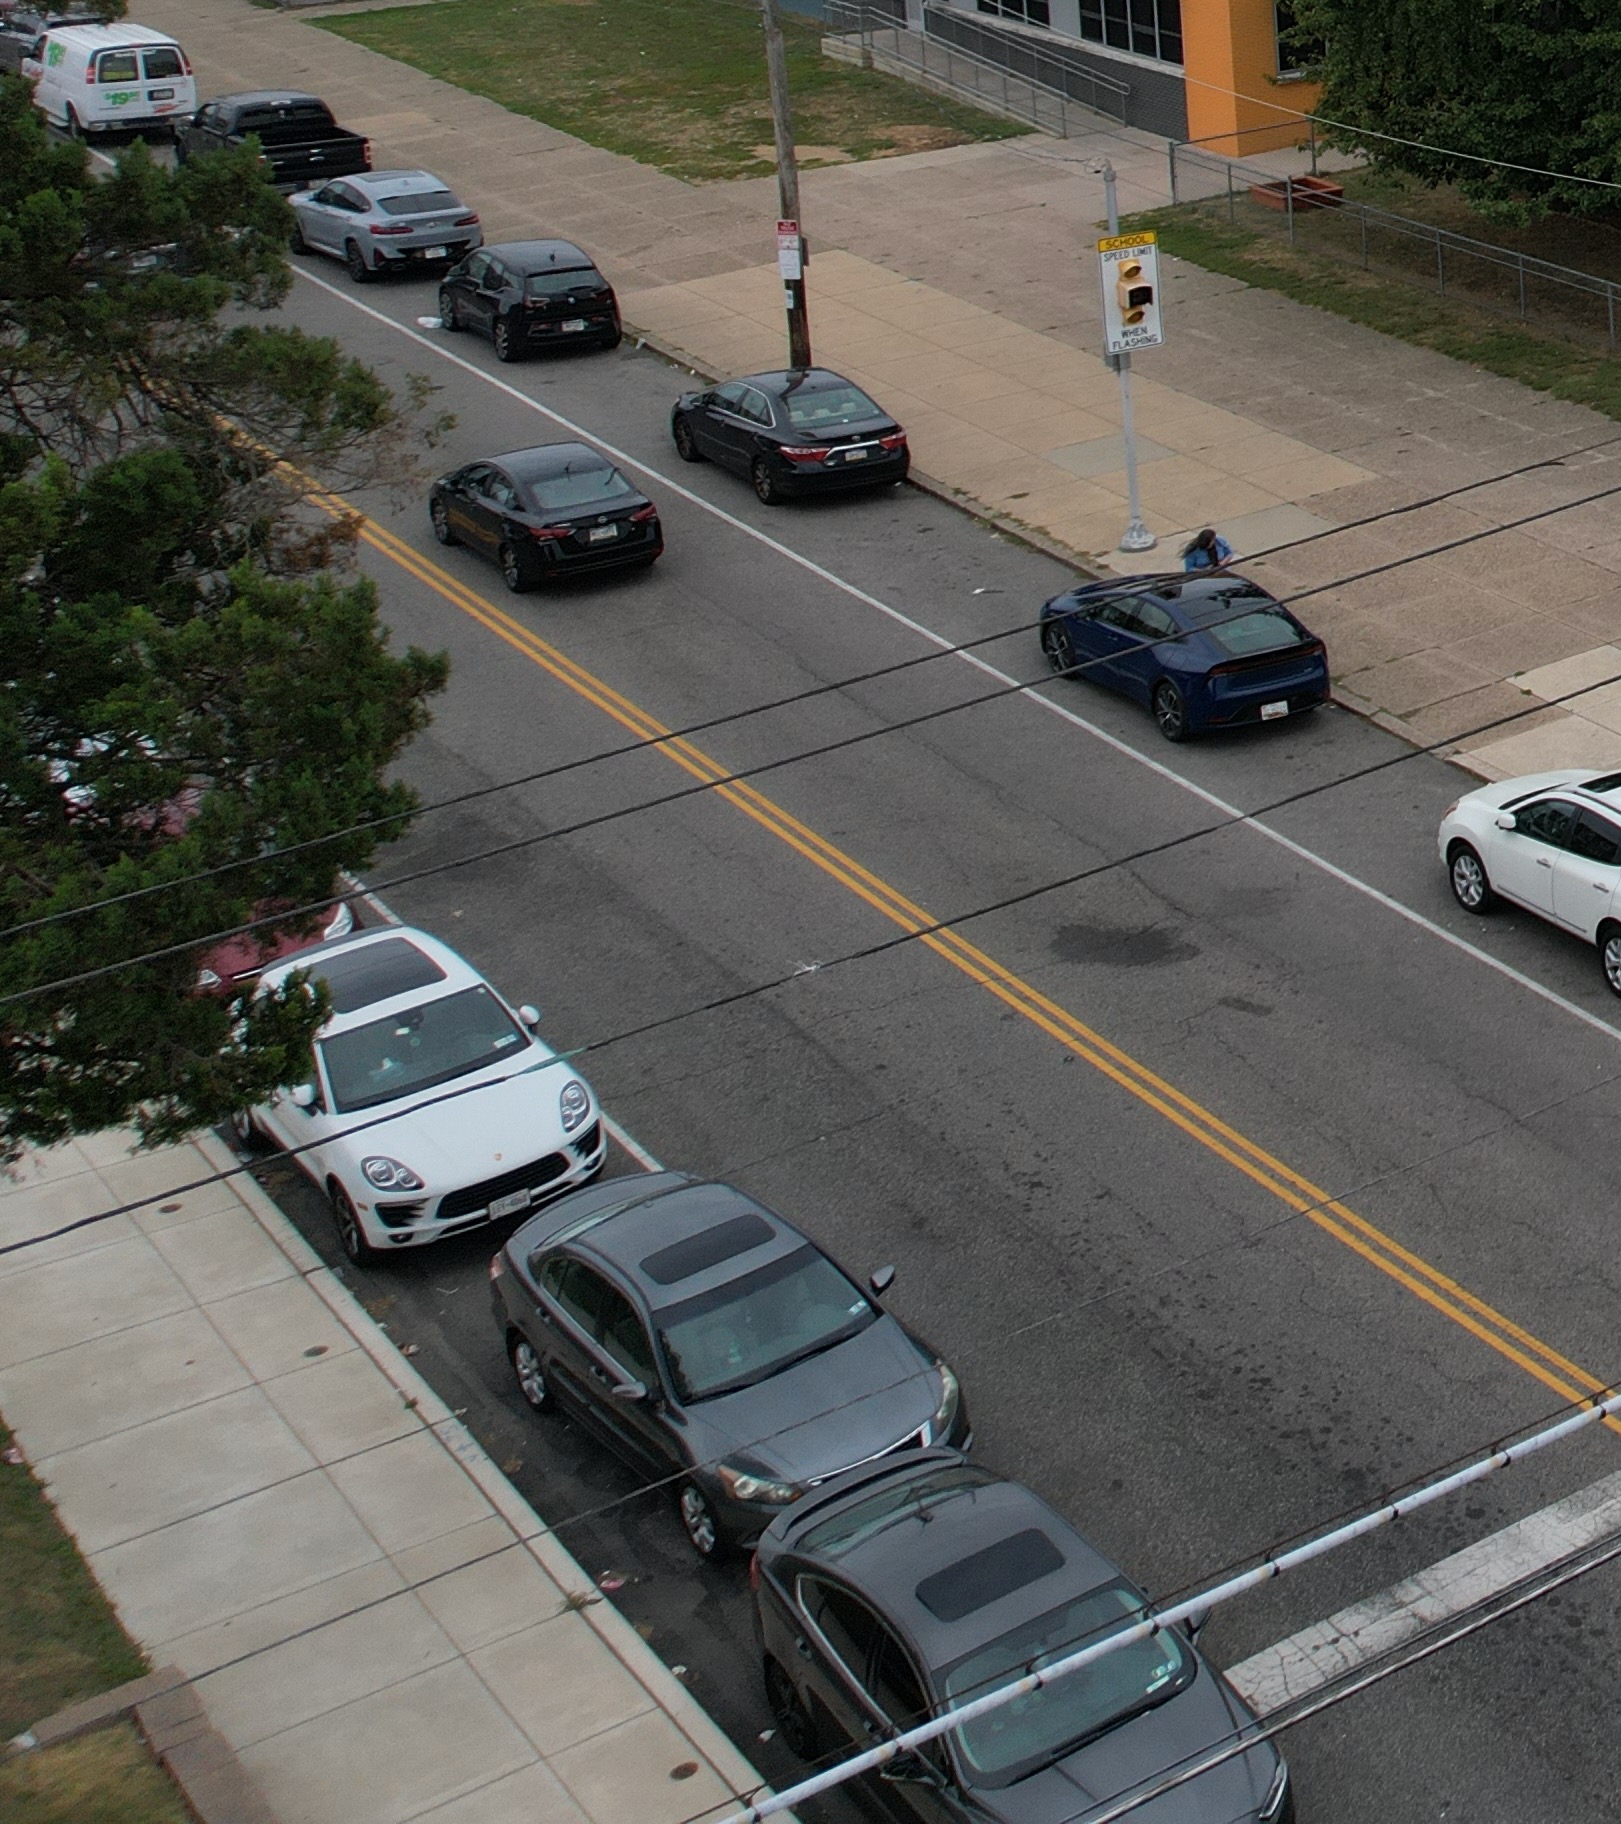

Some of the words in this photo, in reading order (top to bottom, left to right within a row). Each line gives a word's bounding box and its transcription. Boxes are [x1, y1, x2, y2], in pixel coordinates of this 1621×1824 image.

[1105, 235, 1148, 249] SCHOOL
[1104, 250, 1130, 262] SPEED
[1132, 246, 1152, 257] LIMIT
[1121, 326, 1148, 338] WHEN
[1112, 334, 1159, 350] FLASHING
